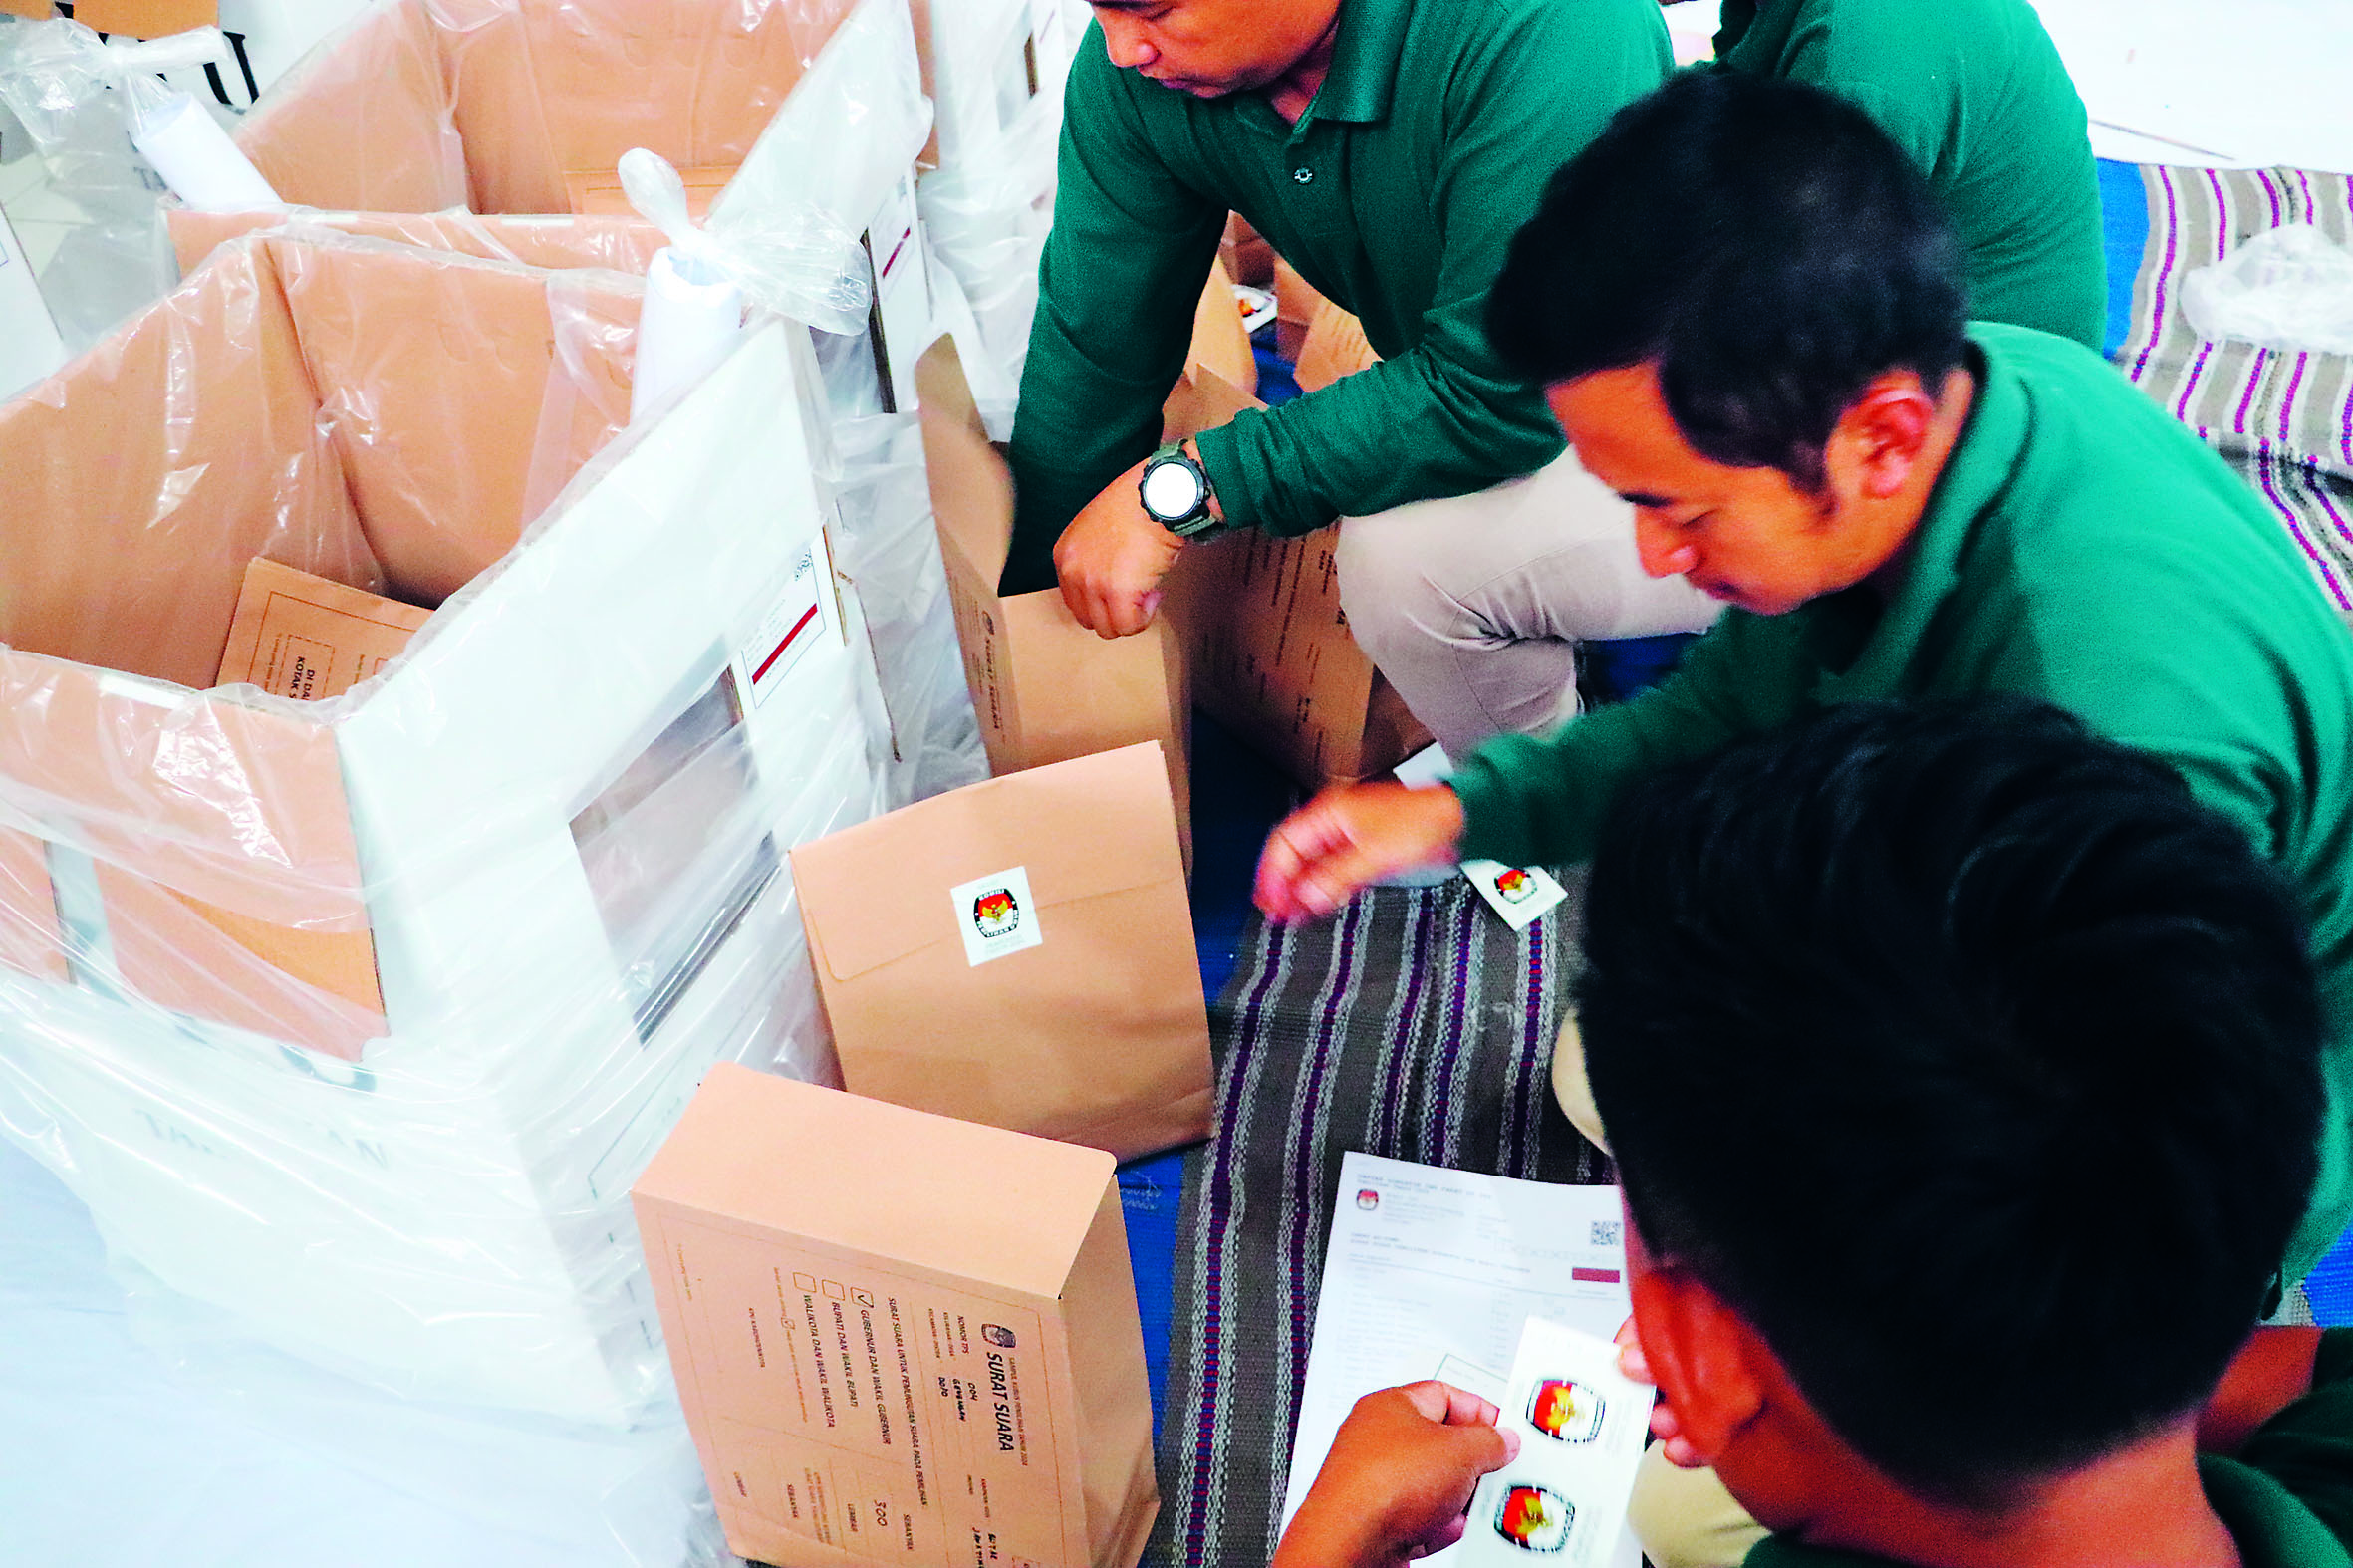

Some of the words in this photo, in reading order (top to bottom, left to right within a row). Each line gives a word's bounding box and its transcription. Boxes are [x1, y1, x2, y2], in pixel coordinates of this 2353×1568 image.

[291, 655, 306, 690] KOTAK
[803, 1294, 819, 1337] WALIKOTA
[832, 1301, 846, 1331] BUPATI
[888, 1296, 900, 1322] SURAT
[837, 1331, 848, 1351] DAN
[860, 1309, 877, 1354] GUBERNUR
[892, 1322, 904, 1347] SUARA
[957, 1315, 968, 1342] NOMOR
[812, 1338, 823, 1359] DAN
[897, 1349, 908, 1374] UNTUK
[816, 1360, 829, 1385] WAKIL
[842, 1352, 854, 1378] WAKIL
[869, 1355, 880, 1375] DAN
[986, 1351, 1009, 1401] SURAT
[846, 1379, 859, 1408] BUPATI
[872, 1376, 884, 1401] WAKIL
[821, 1386, 836, 1428] WALIKOTA
[877, 1403, 892, 1445] GUBERNUR
[909, 1424, 919, 1448] SUARA
[993, 1402, 1015, 1451] SUARA
[873, 1499, 888, 1527] 300
